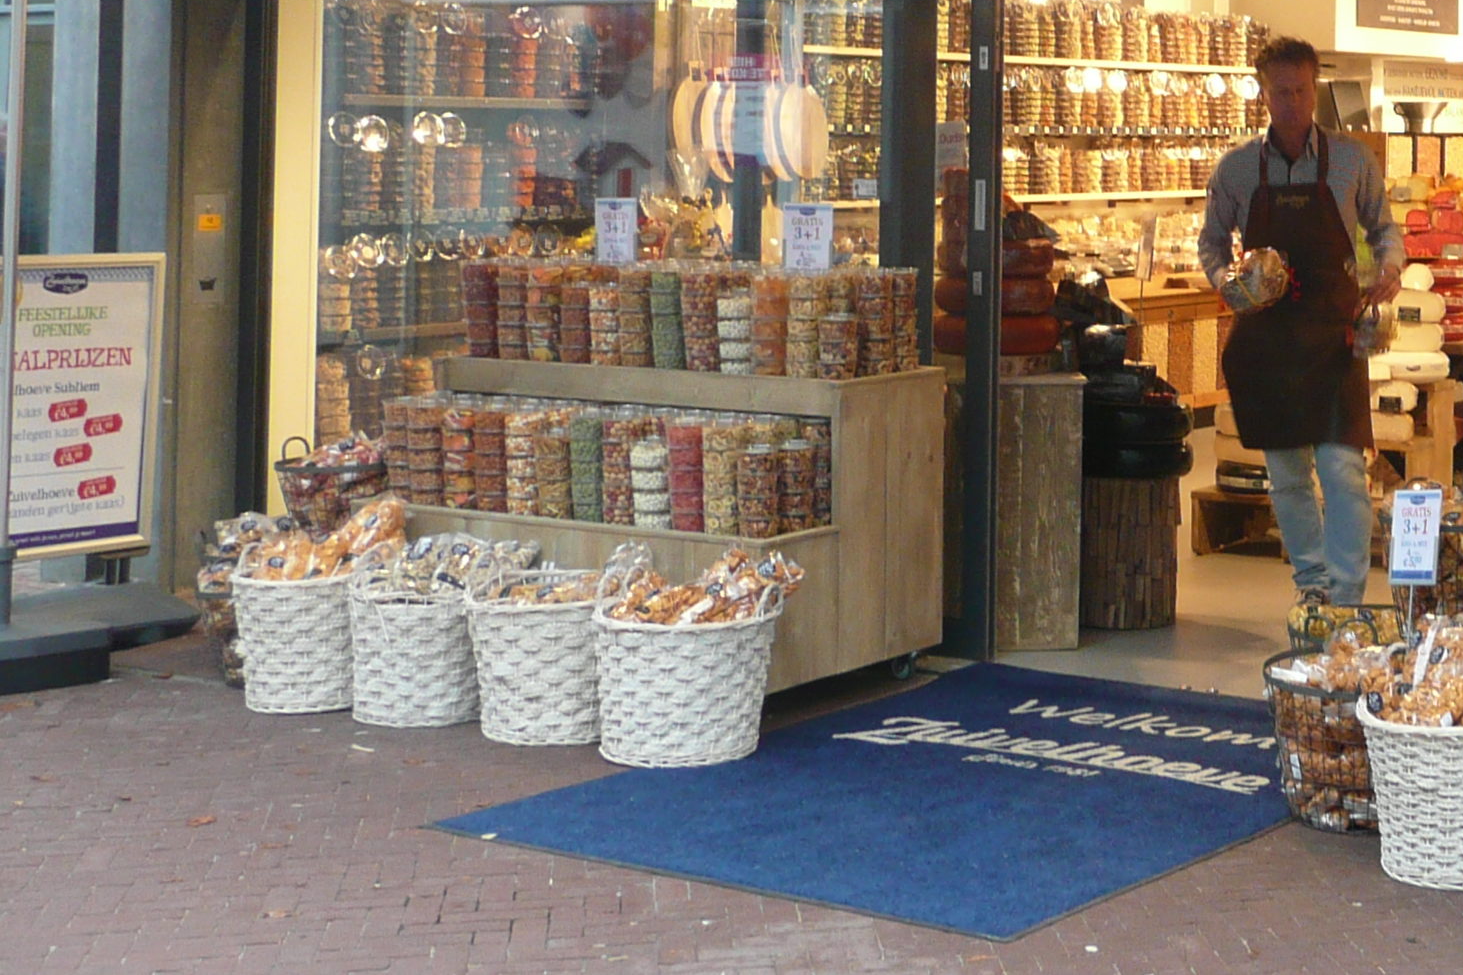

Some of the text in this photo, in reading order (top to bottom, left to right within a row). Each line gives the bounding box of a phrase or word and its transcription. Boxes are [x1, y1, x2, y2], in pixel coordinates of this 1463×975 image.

[18, 306, 108, 322] FEESTELIJKE
[32, 323, 91, 337] OPENING
[54, 382, 100, 395] Subliem
[1402, 507, 1432, 517] GRATIS
[1008, 699, 1276, 750] Welkom
[832, 717, 1270, 794] Zuivelhoeve
